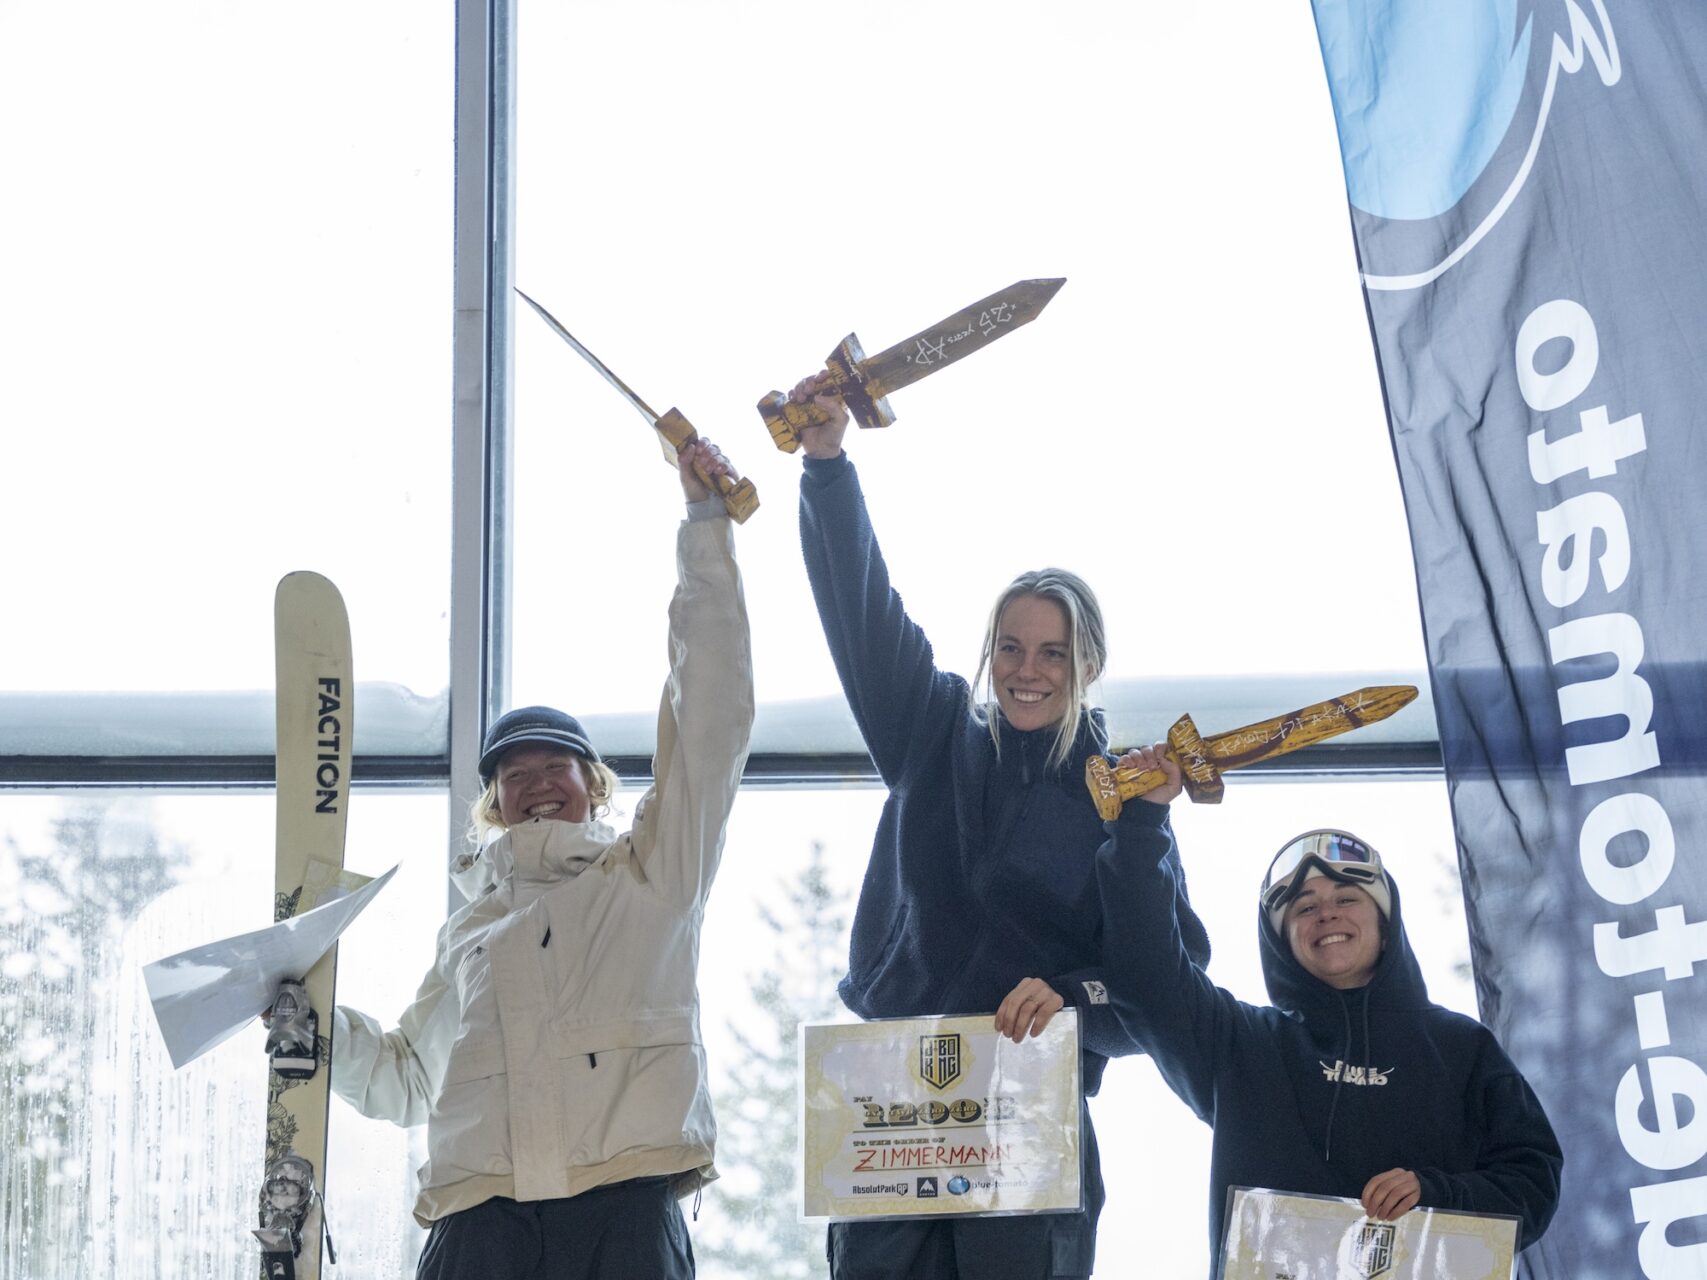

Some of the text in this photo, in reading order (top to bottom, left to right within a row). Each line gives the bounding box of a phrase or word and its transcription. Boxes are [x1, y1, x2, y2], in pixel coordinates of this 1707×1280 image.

[915, 302, 1012, 365] 25 years AP
[315, 677, 341, 814] FACTION
[853, 1144, 1012, 1171] ZIMMERMANN
[852, 1183, 896, 1195] AbsolutPark
